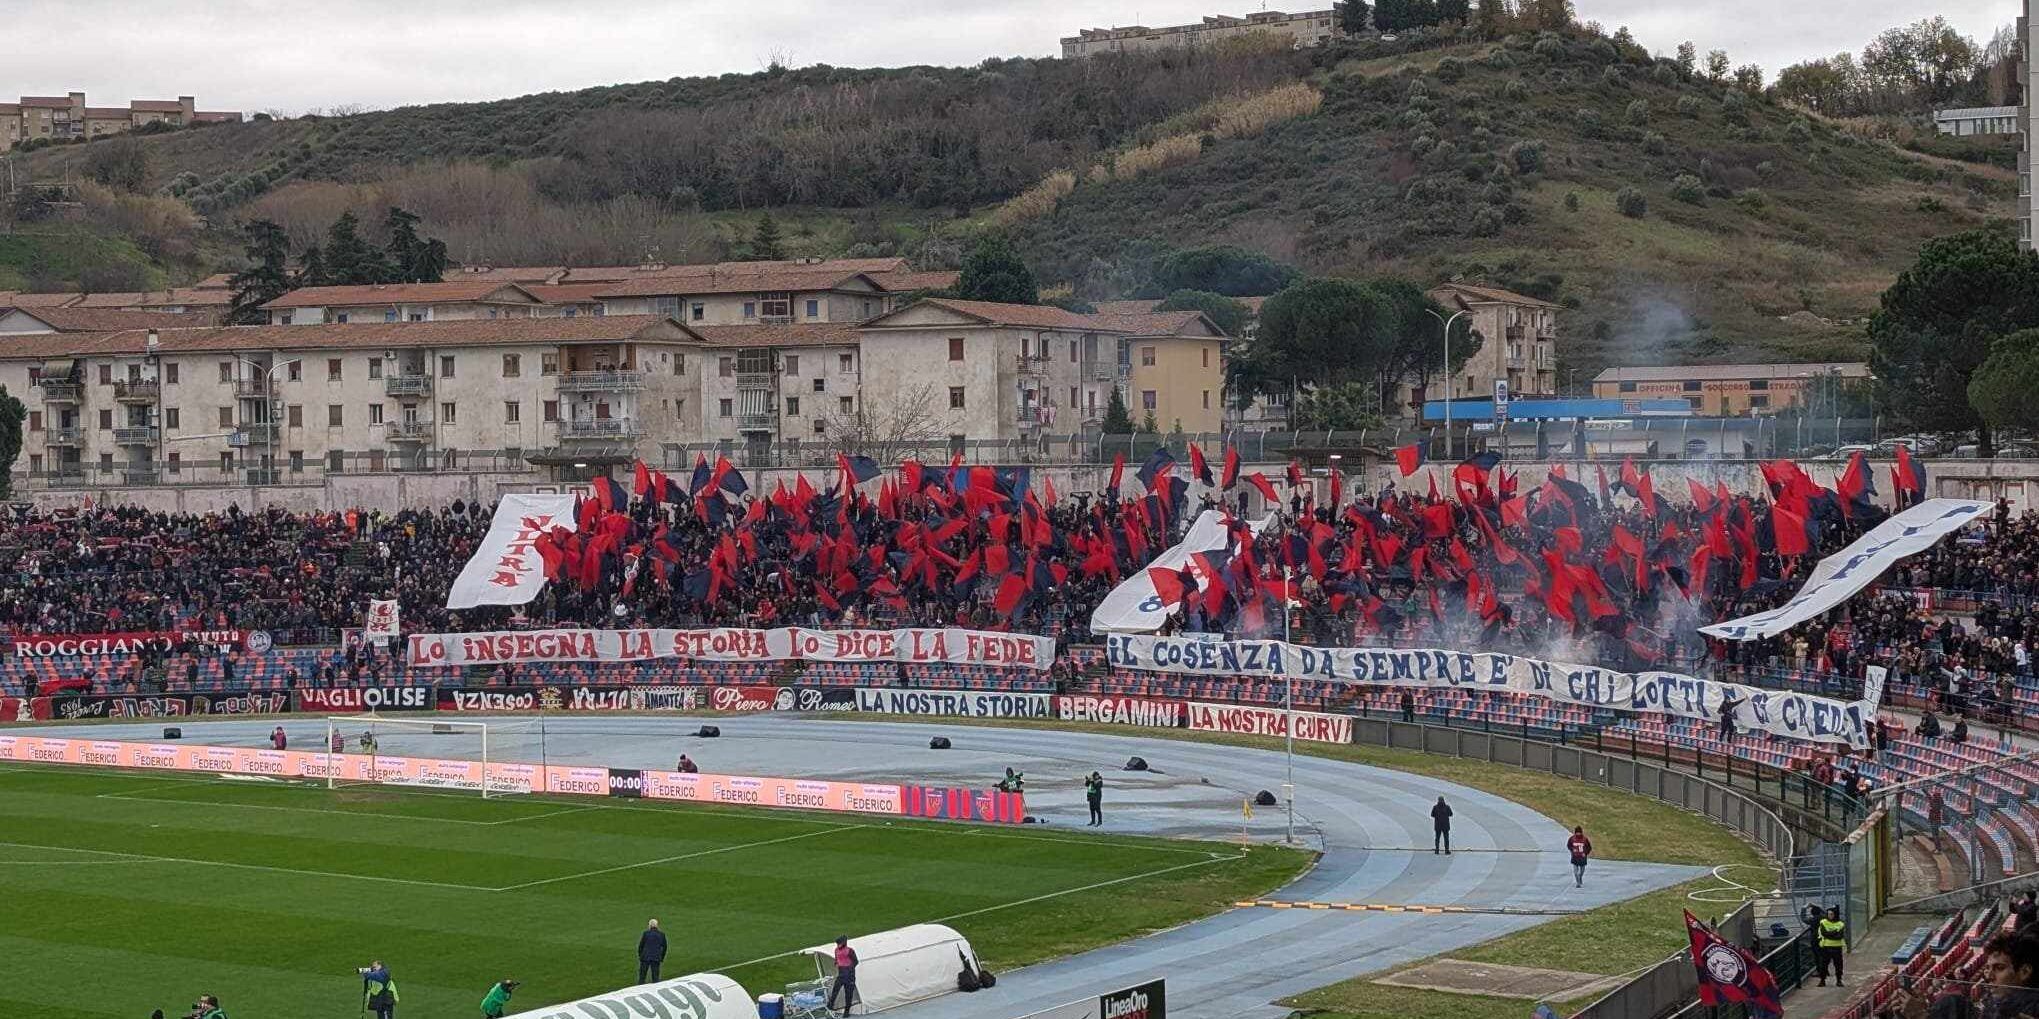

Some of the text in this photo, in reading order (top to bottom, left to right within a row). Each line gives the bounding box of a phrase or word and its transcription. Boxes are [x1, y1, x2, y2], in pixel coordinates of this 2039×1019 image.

[1707, 384, 1750, 392] SOCCORSO
[617, 631, 655, 659] LA
[911, 630, 948, 660] LA
[966, 634, 1035, 663] FEDE
[1302, 650, 1336, 679] DA
[1353, 651, 1476, 686] SEMPRE
[713, 686, 768, 711] Piero
[800, 688, 856, 712] Romeo
[861, 691, 1047, 718] LA NOSTRA STORIA
[1059, 697, 1179, 727] BERGAMINI
[1191, 706, 1214, 730] LA
[1218, 710, 1288, 735] NOSTRA
[28, 743, 64, 760] FEDERICO
[79, 746, 117, 764] FEDERICO
[134, 749, 174, 767] FEDERICO
[191, 752, 232, 770] FEDERICO
[241, 754, 283, 773] FEDERICO
[301, 758, 341, 776] FEDERCO
[551, 773, 600, 792] FEDERICO
[609, 776, 641, 790] 00:00
[651, 778, 695, 798] FEDERICO
[713, 781, 758, 802] FEDERICO
[777, 786, 823, 807] FEDERICO
[843, 790, 892, 811] FEDERICO
[1105, 991, 1148, 1018] LineaOro
